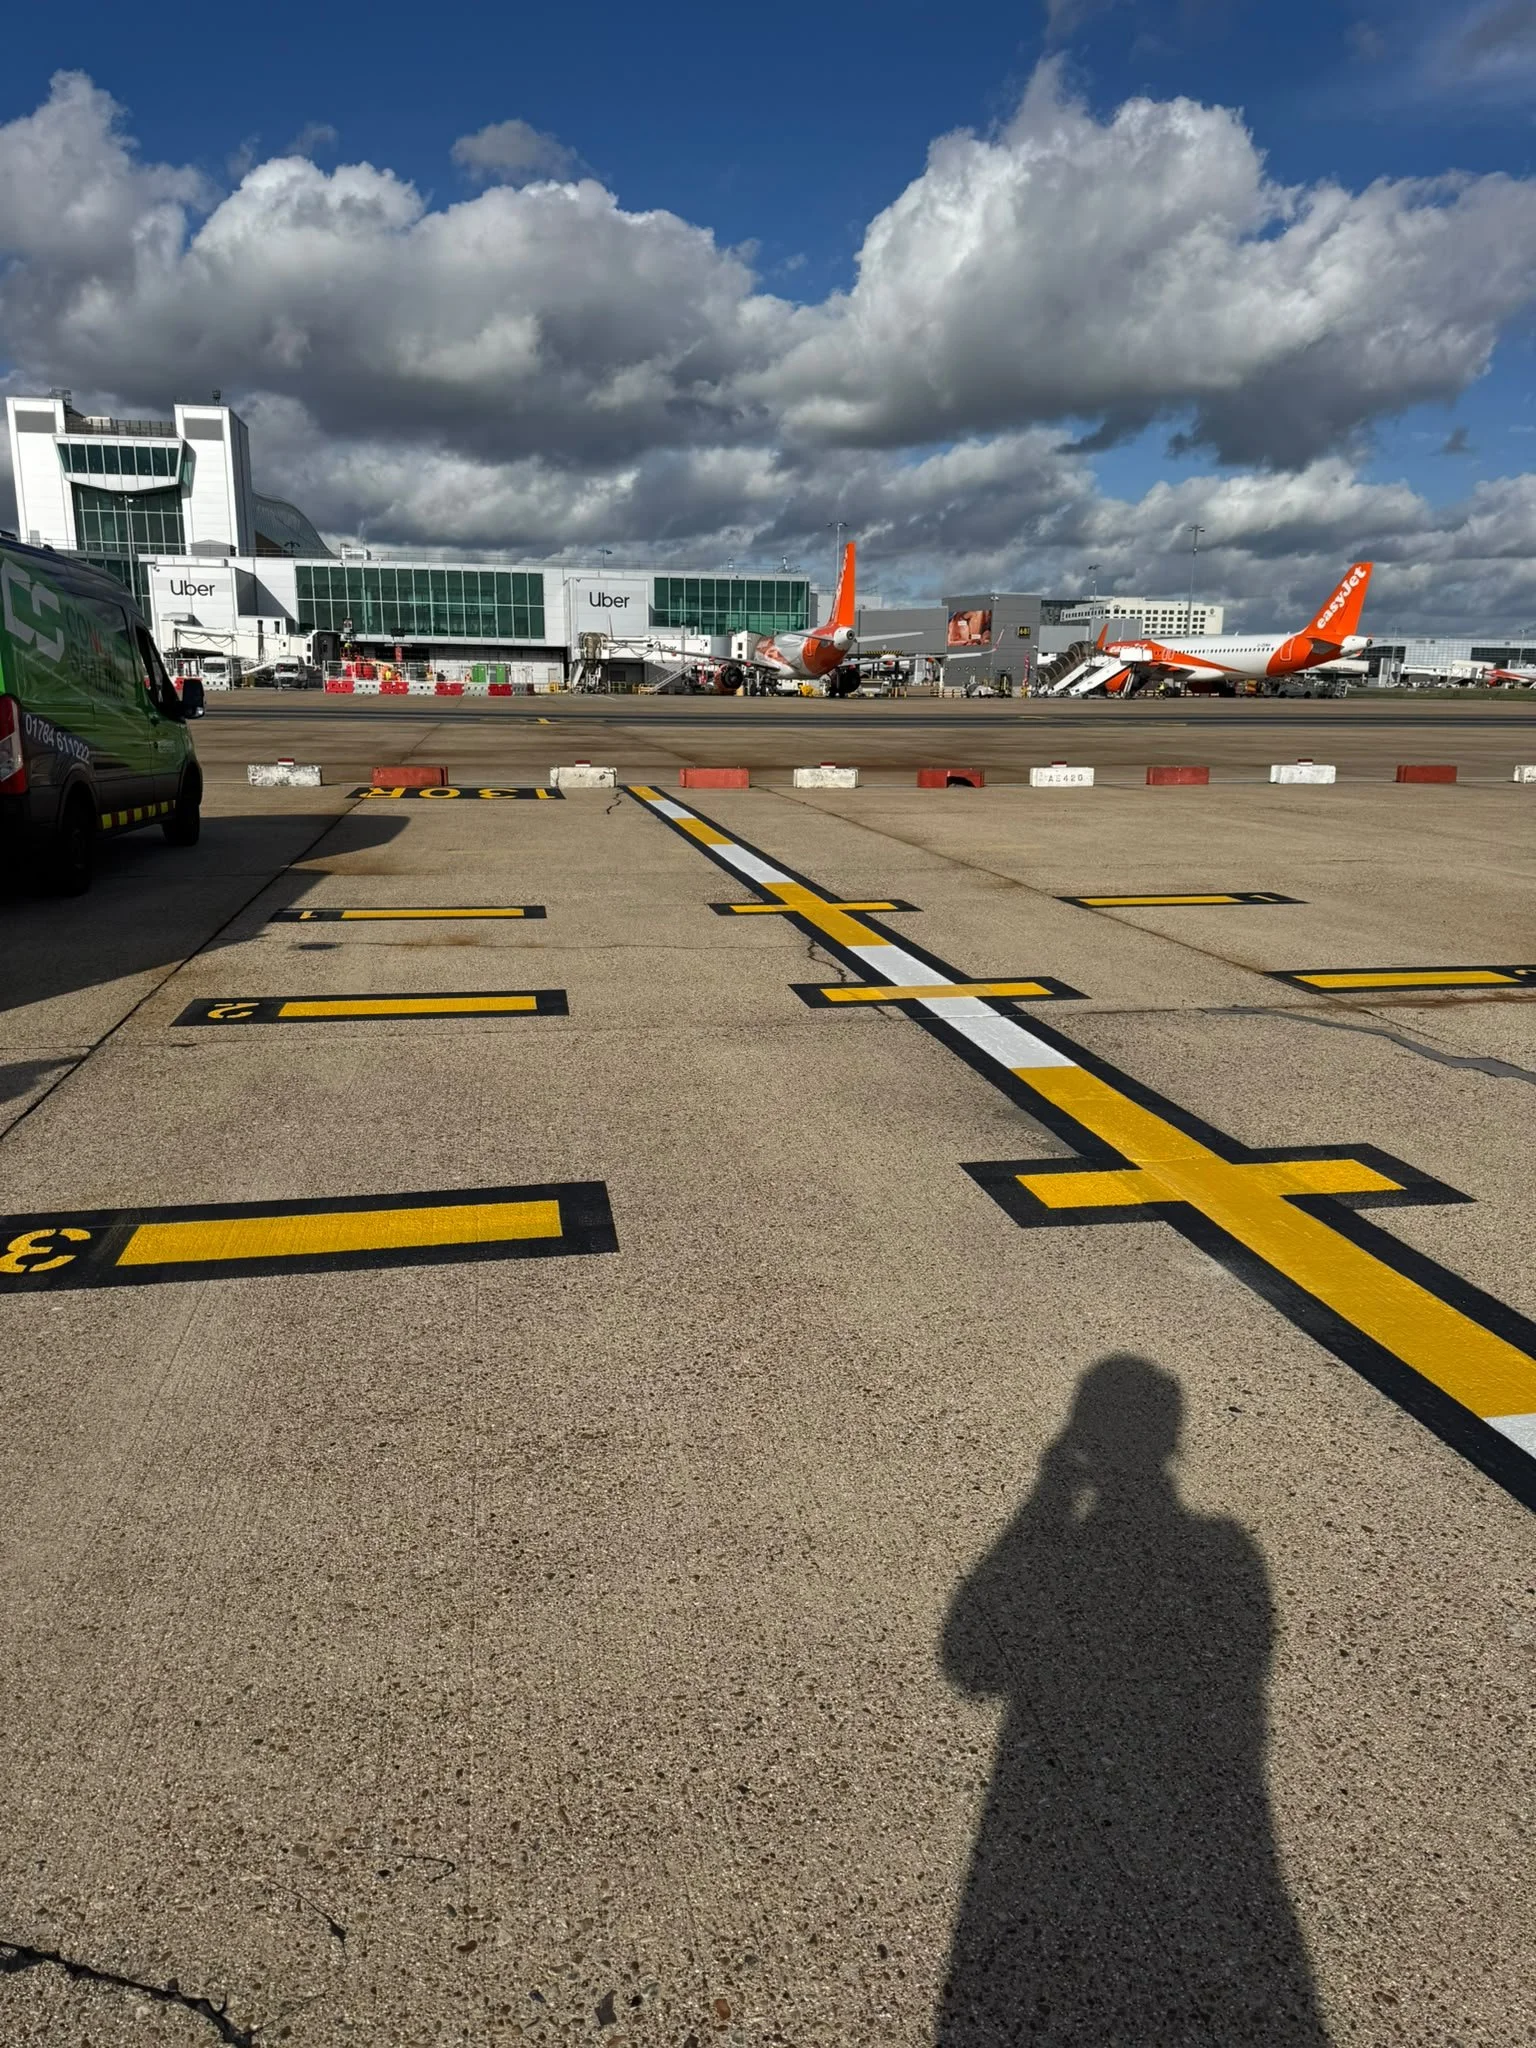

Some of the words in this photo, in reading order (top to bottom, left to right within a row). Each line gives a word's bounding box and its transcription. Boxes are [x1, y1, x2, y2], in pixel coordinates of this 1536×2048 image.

[170, 579, 216, 597] Uber
[589, 591, 630, 608] Uber
[1317, 566, 1366, 629] easyJet
[25, 714, 55, 746] 01784
[207, 1002, 260, 1018] 2
[0, 1227, 91, 1273] 3
